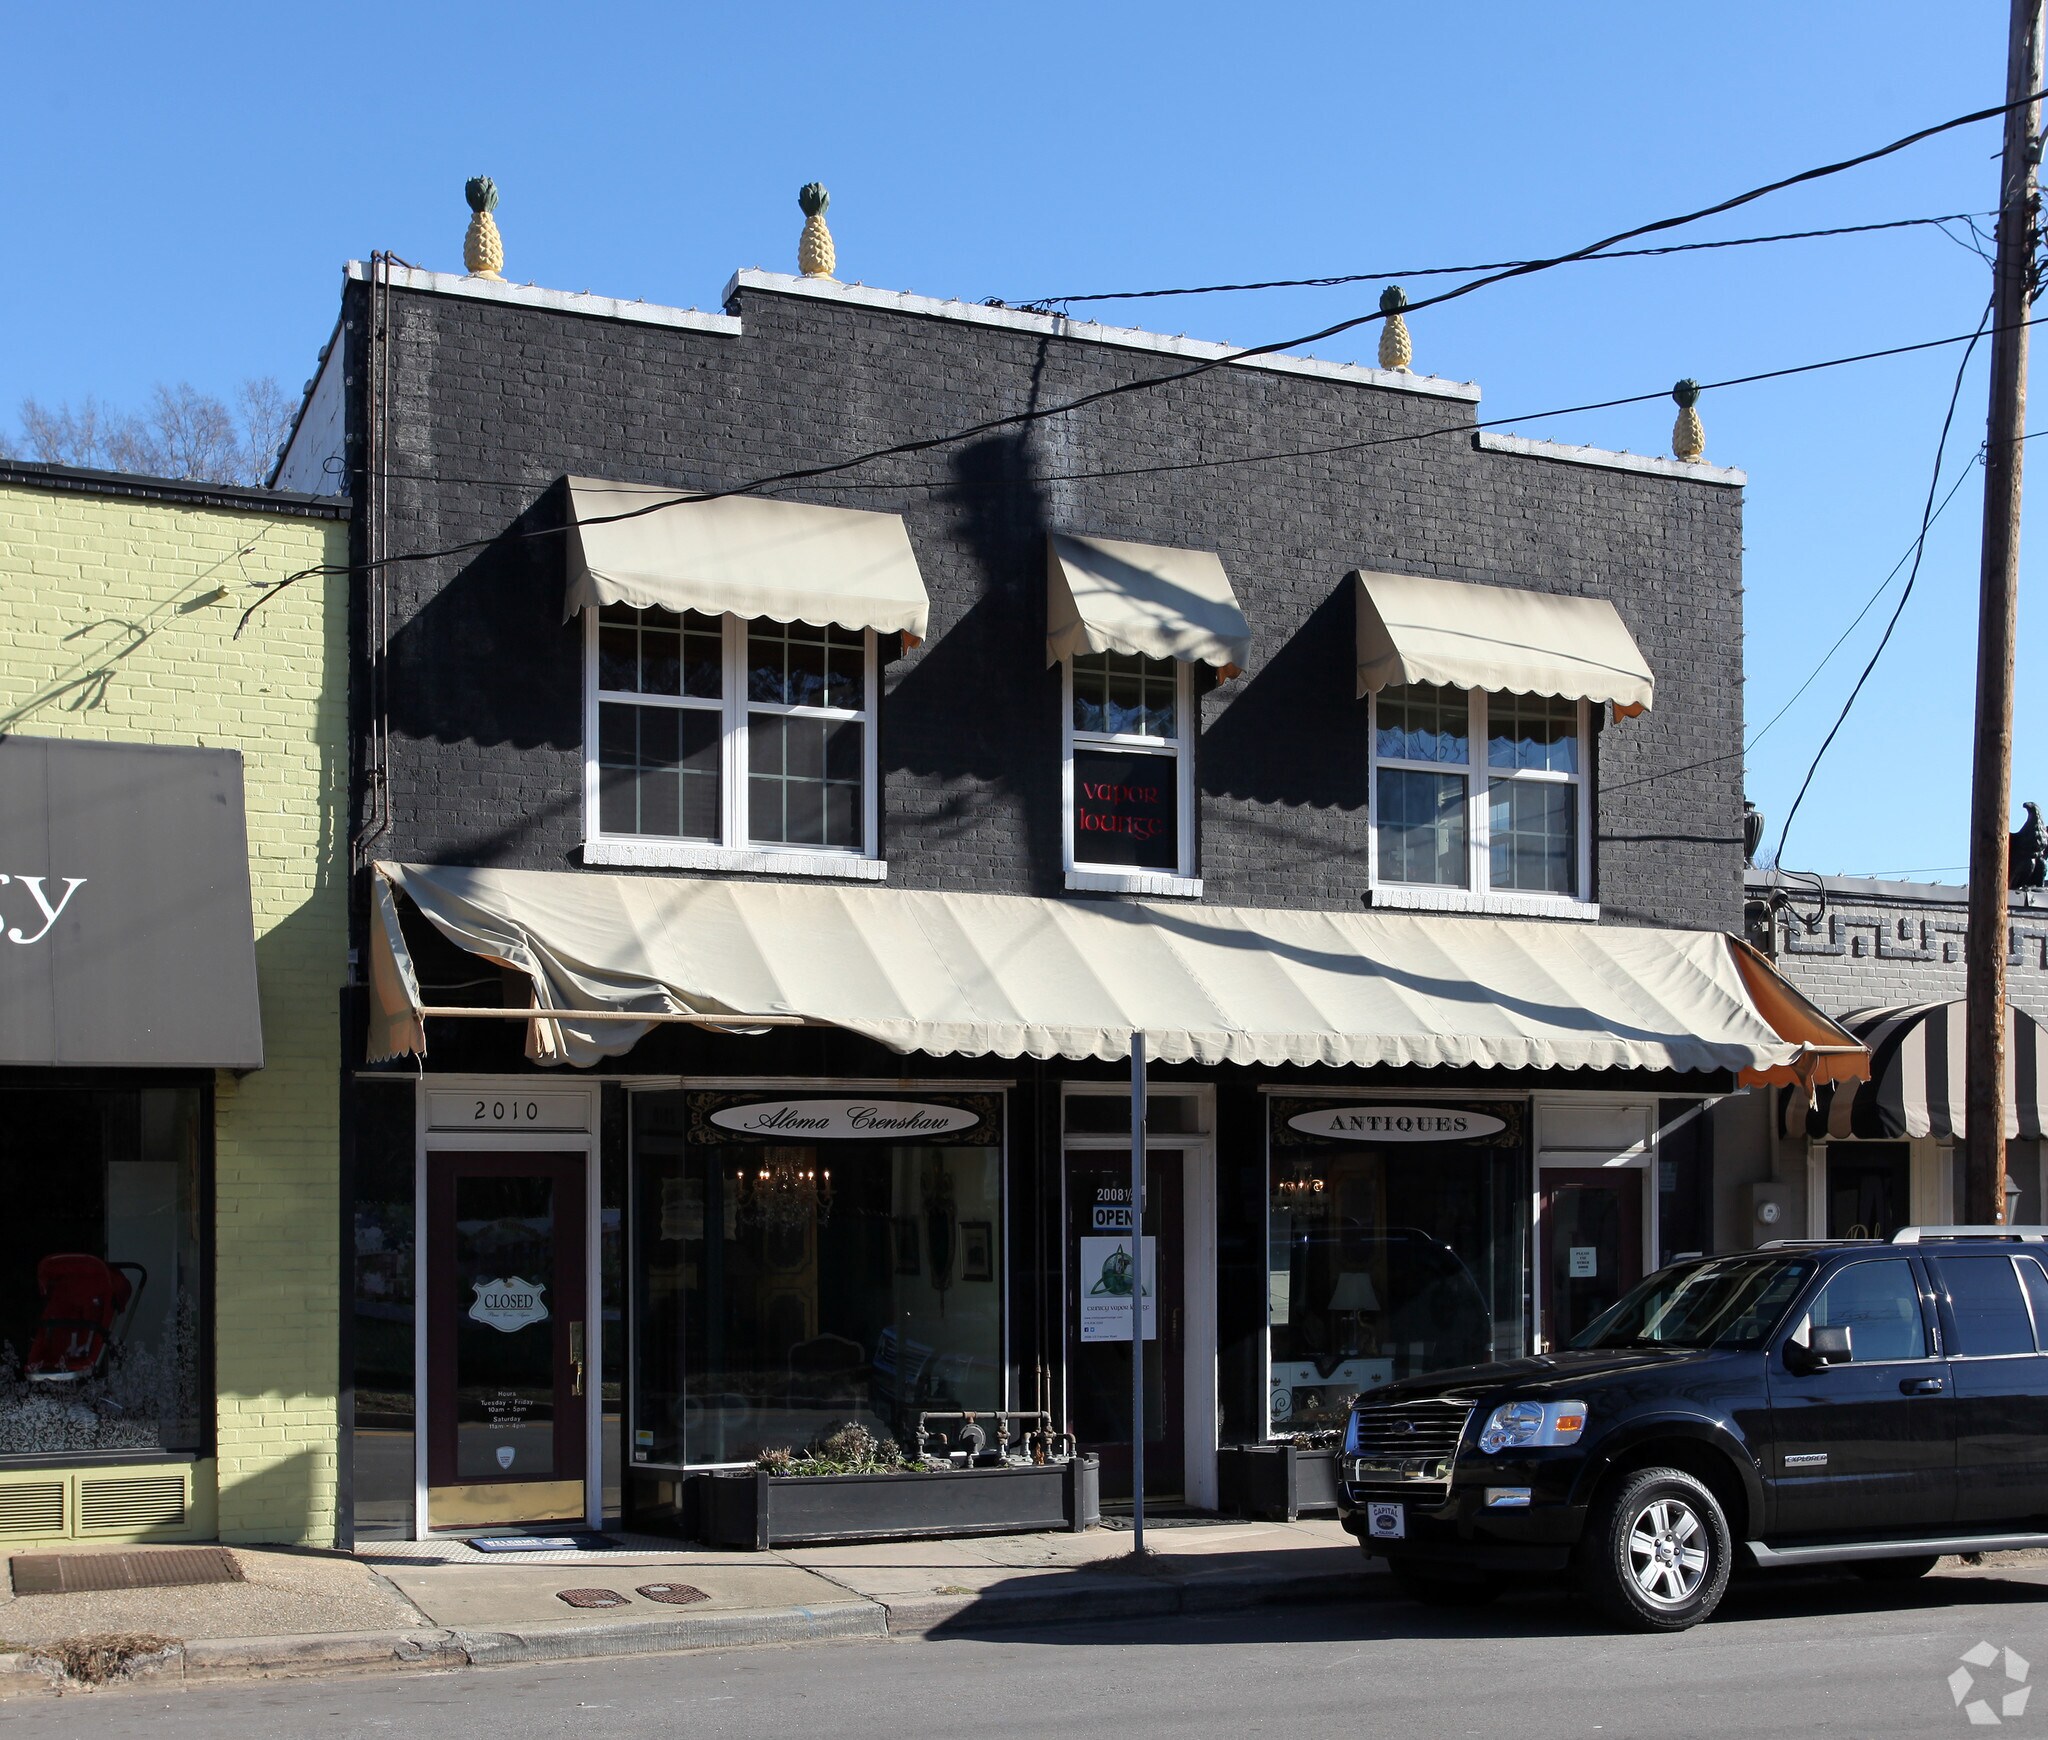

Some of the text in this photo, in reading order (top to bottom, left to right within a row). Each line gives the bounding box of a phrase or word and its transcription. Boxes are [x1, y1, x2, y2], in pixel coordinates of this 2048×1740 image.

[1079, 807, 1163, 840] lounge
[474, 1101, 538, 1120] 2010
[743, 1106, 950, 1129] Aloma Crenshaw
[1329, 1115, 1469, 1132] ANTIQUES
[1095, 1208, 1133, 1226] OPEN
[484, 1294, 534, 1309] CLOSED
[1786, 1454, 1828, 1463] EXPLORER
[1374, 1507, 1398, 1517] CAPITAL
